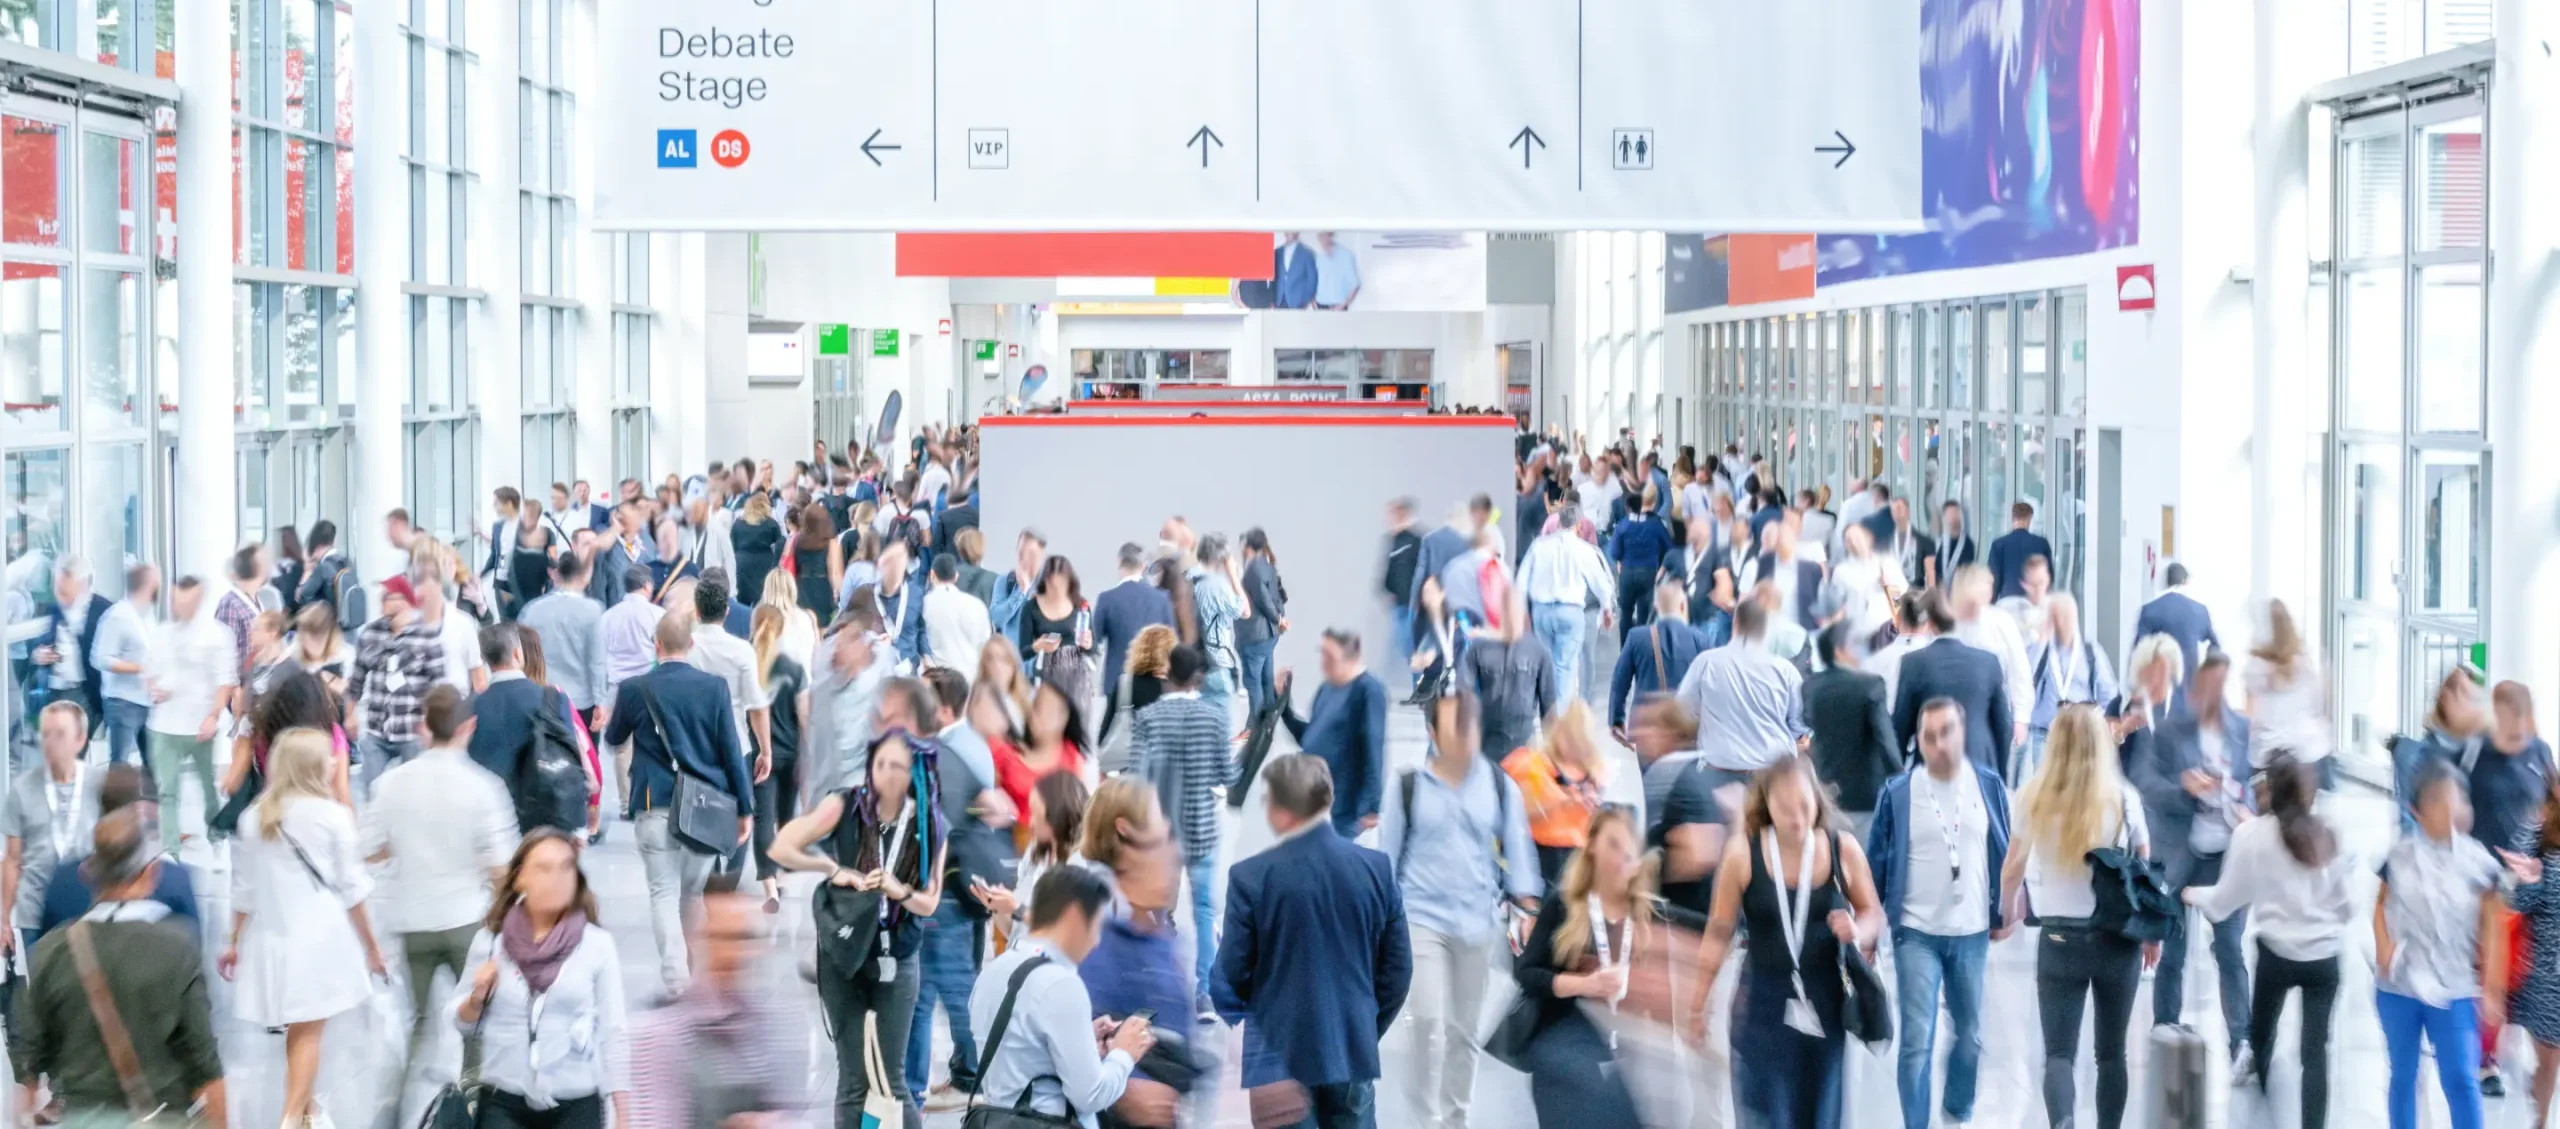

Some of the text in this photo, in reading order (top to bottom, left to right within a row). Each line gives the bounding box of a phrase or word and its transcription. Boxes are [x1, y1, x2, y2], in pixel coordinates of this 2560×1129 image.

[658, 26, 794, 59] Debate
[658, 70, 767, 109] Stage
[664, 138, 690, 158] AL
[717, 138, 743, 159] DS
[974, 142, 1003, 156] VIP
